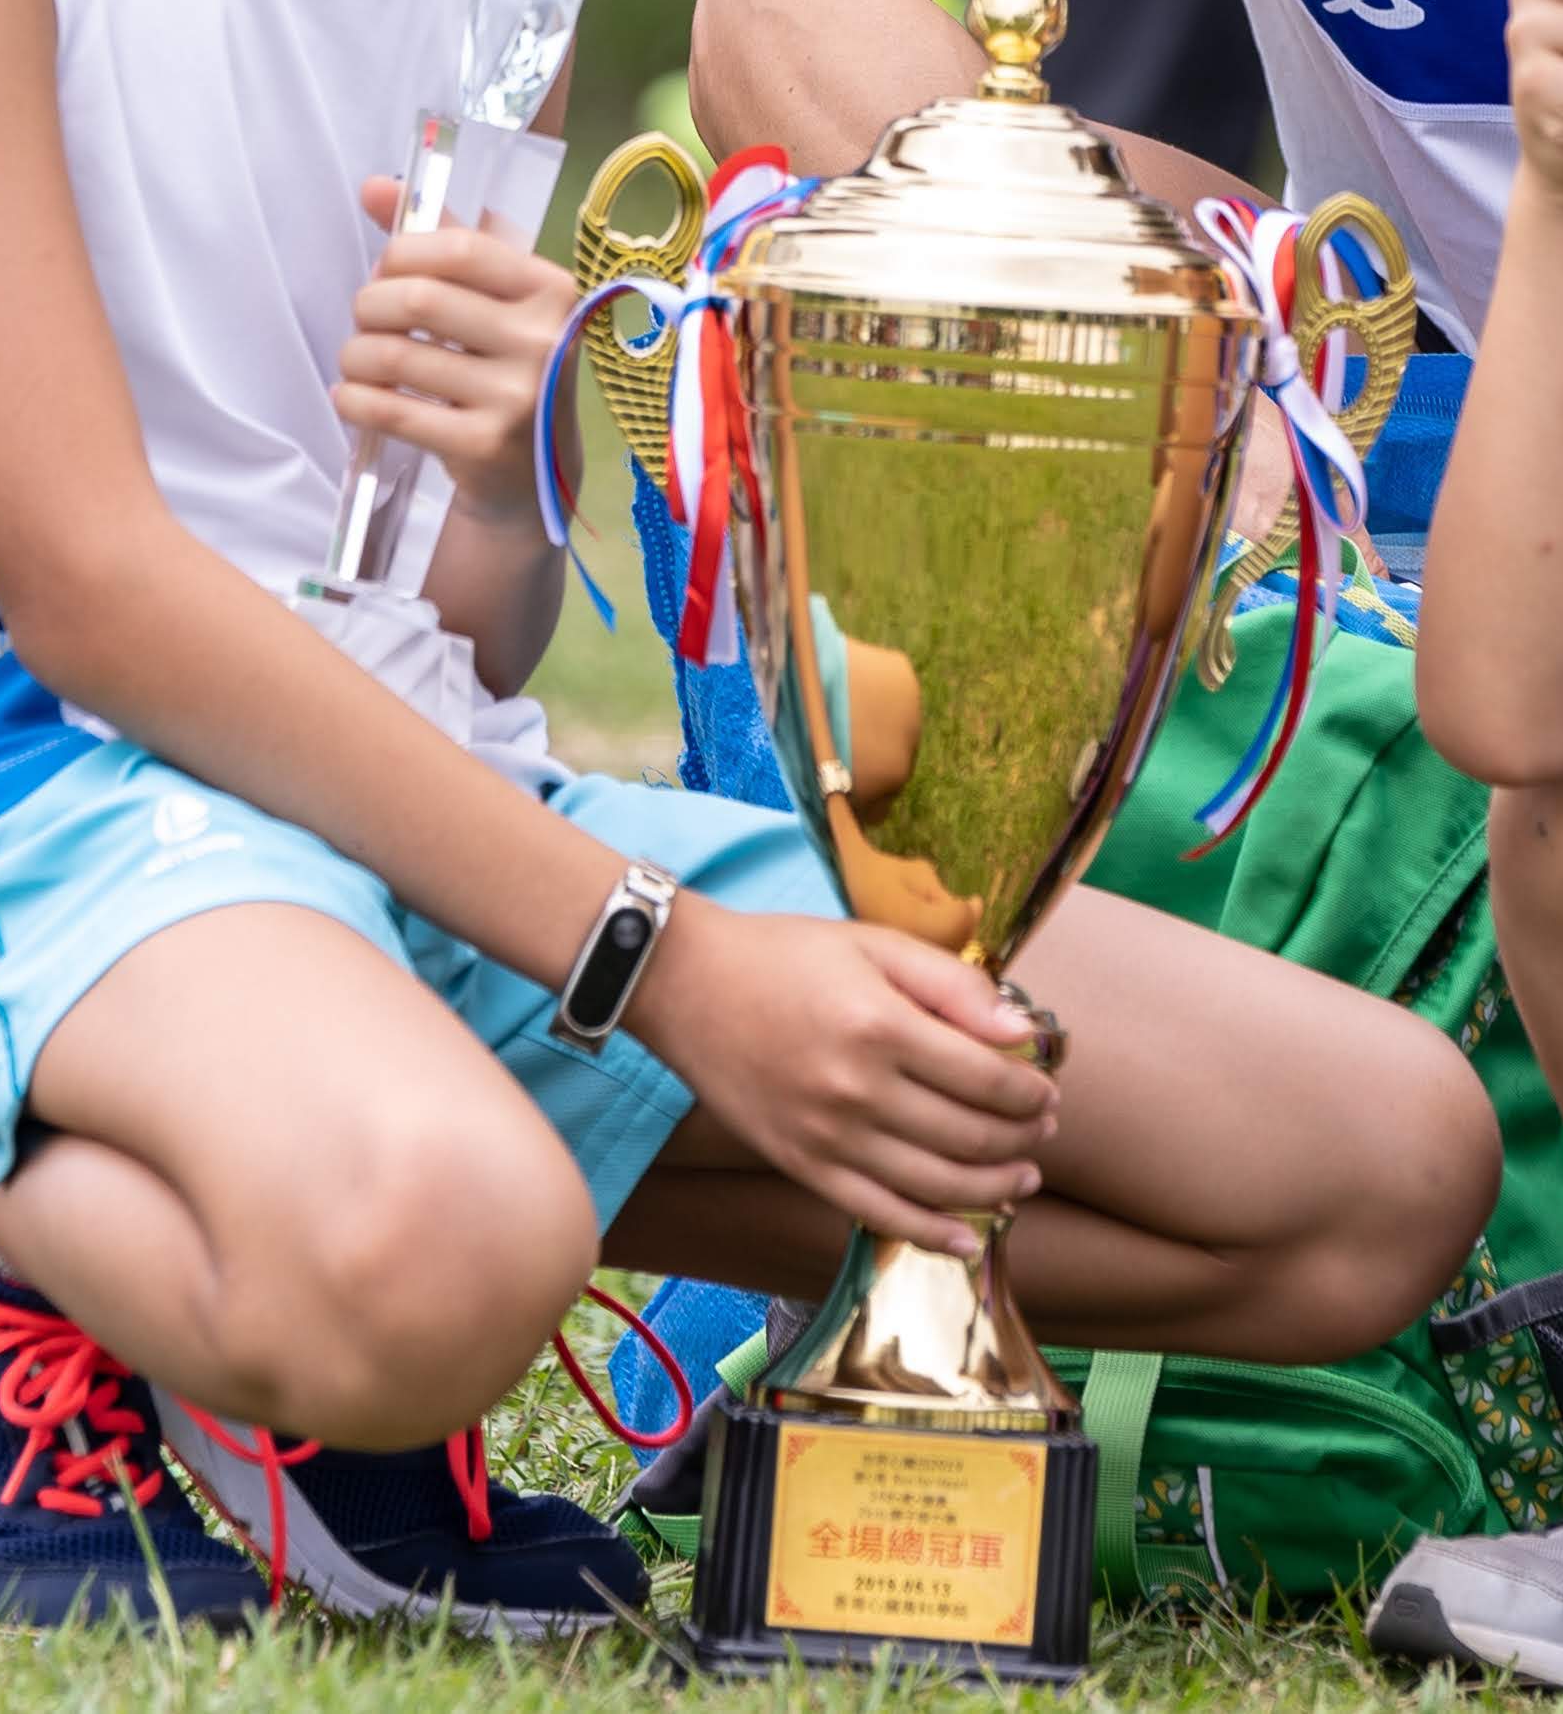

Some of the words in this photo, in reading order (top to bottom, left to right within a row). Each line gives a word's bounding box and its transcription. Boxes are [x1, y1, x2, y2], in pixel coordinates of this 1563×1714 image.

[805, 1517, 1006, 1569] 全場總冠軍
